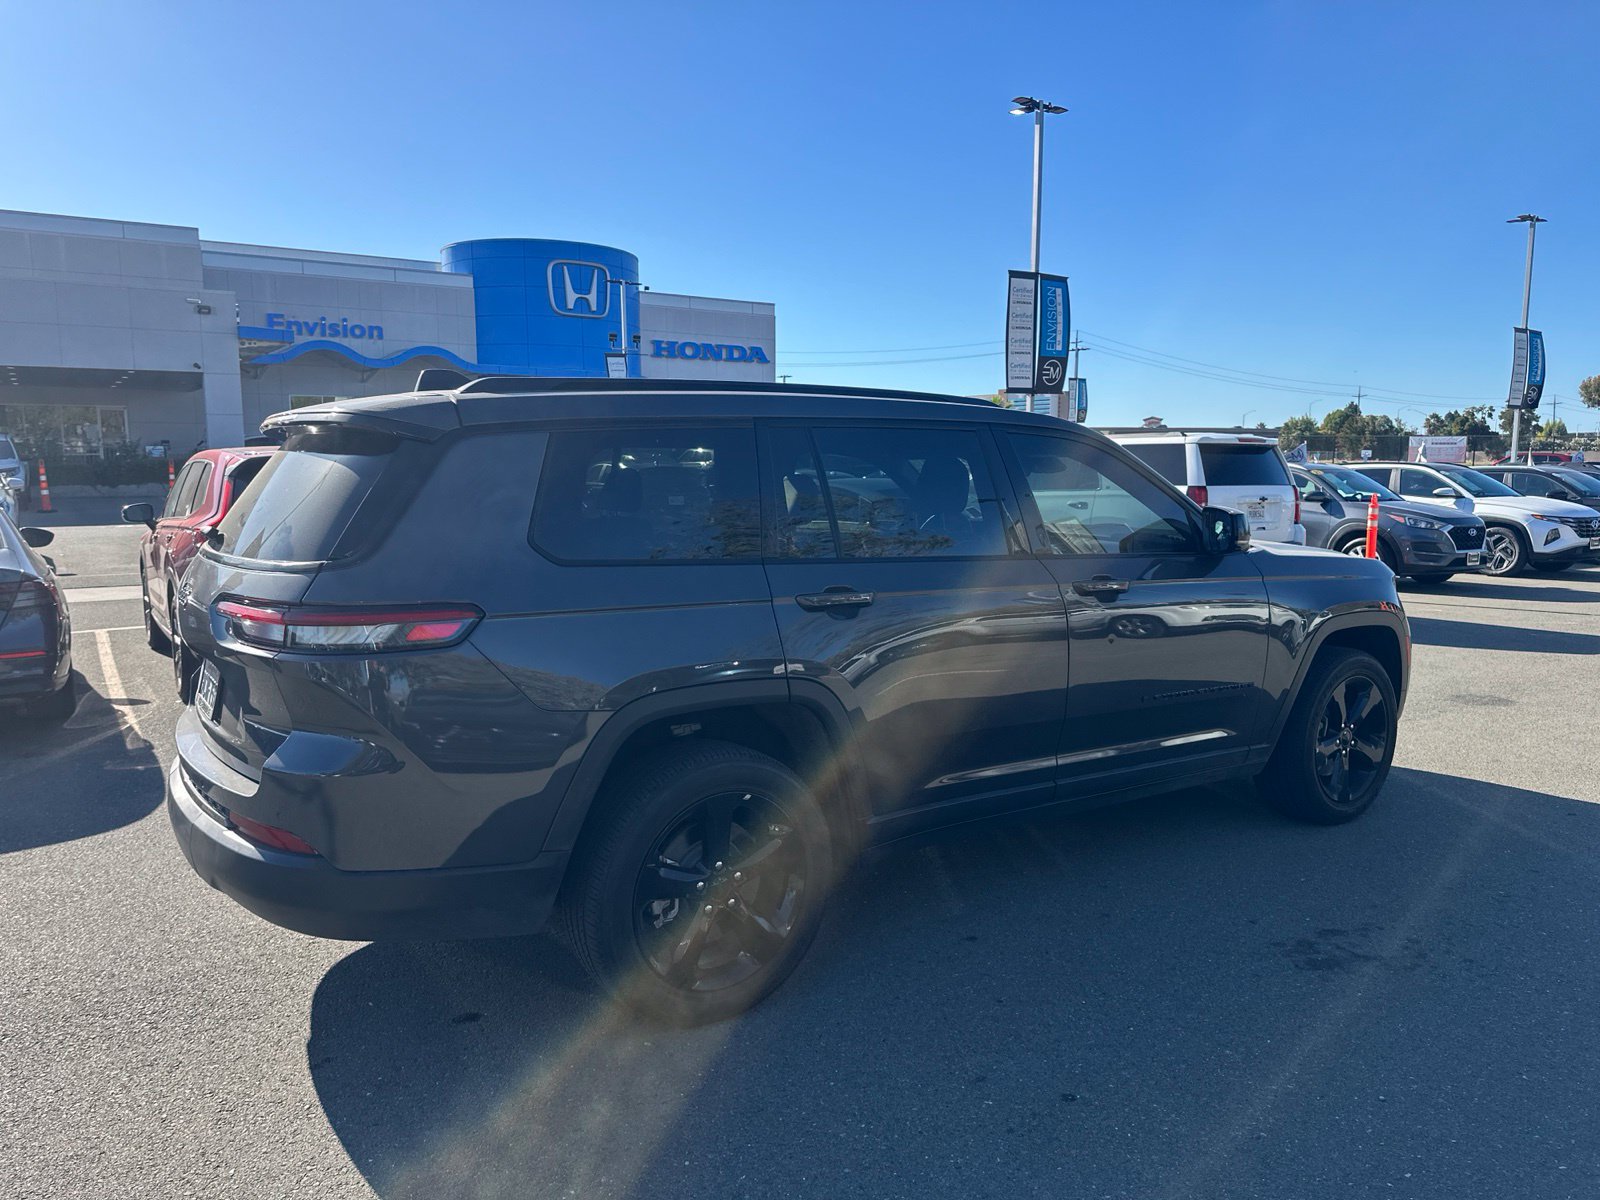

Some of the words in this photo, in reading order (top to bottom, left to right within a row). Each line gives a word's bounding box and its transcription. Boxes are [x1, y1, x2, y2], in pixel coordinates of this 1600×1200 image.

[266, 313, 384, 340] Envision
[1046, 286, 1057, 351] ENVISION
[650, 339, 770, 364] HONDA
